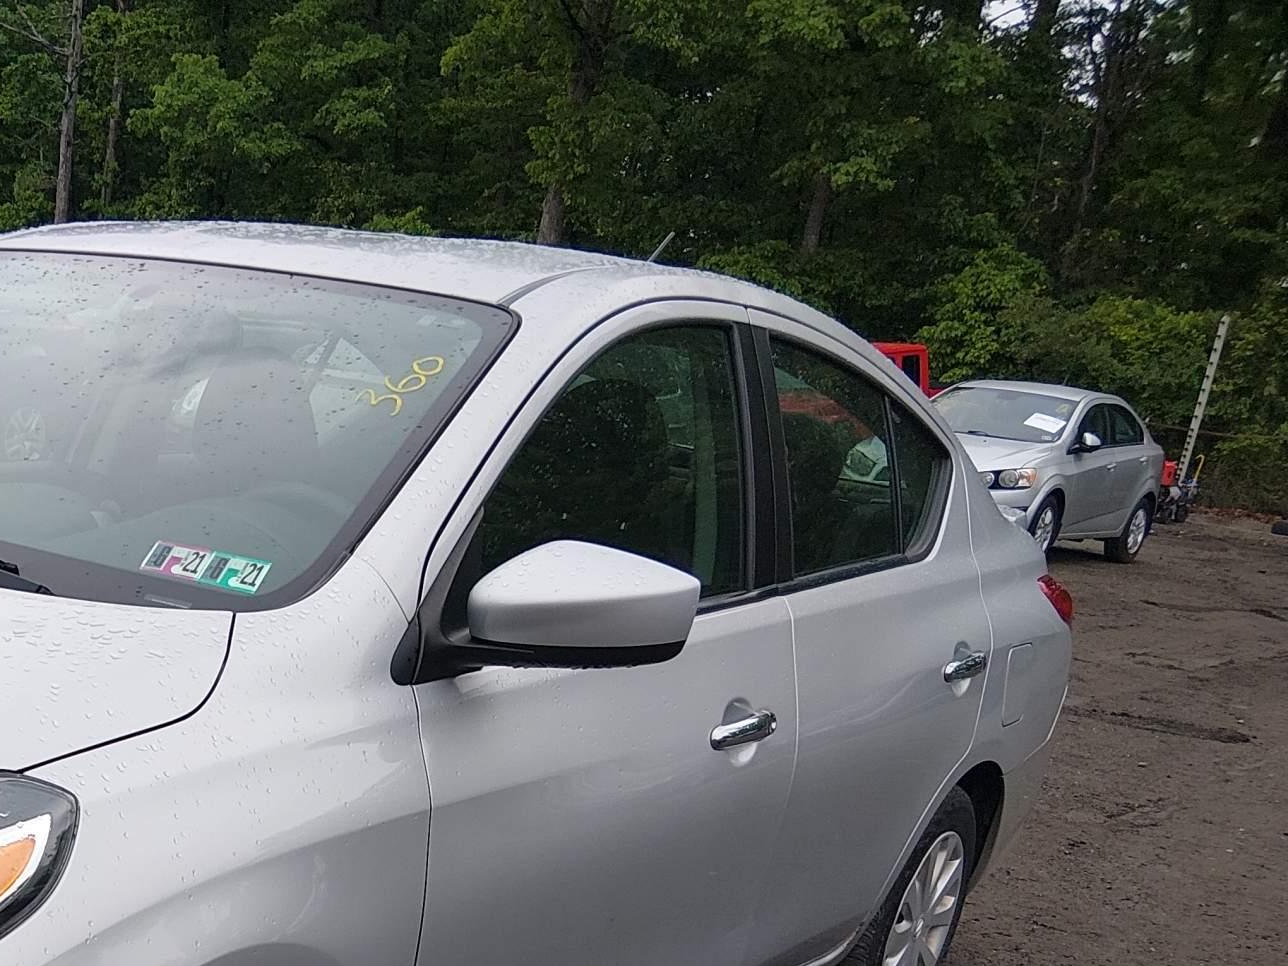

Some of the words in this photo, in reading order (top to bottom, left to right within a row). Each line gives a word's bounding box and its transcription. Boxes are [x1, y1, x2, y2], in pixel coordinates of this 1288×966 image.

[354, 356, 445, 416] 360
[182, 551, 207, 574] 21
[240, 562, 264, 587] 21
